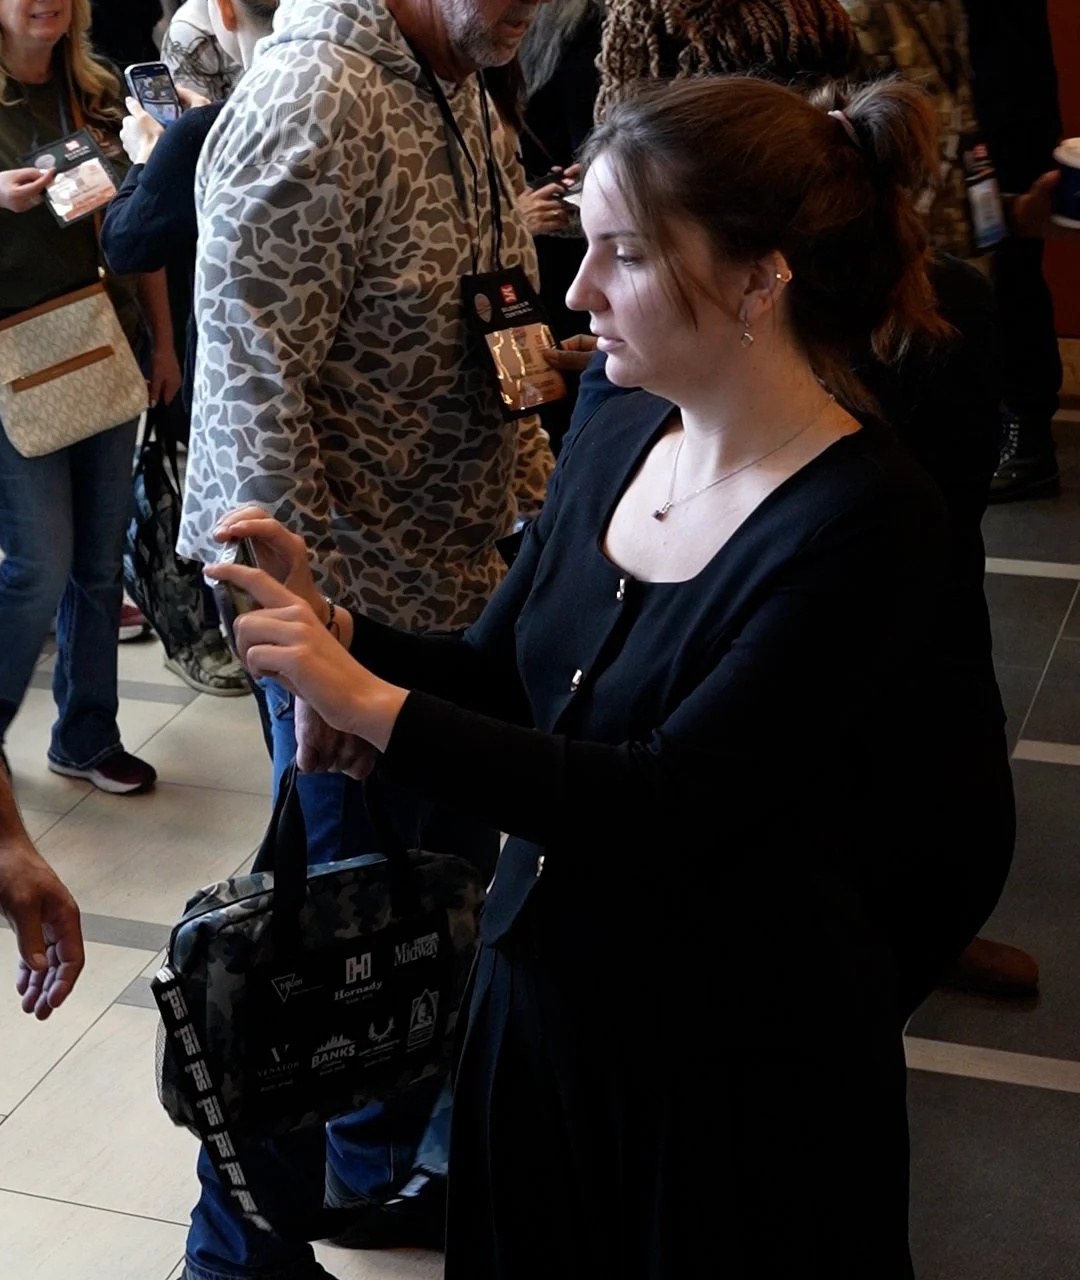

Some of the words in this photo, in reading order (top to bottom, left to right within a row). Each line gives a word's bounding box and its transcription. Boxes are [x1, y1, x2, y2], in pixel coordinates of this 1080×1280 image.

[393, 937, 439, 967] Midway
[334, 980, 384, 1001] Hornady
[311, 1044, 356, 1069] BANKS
